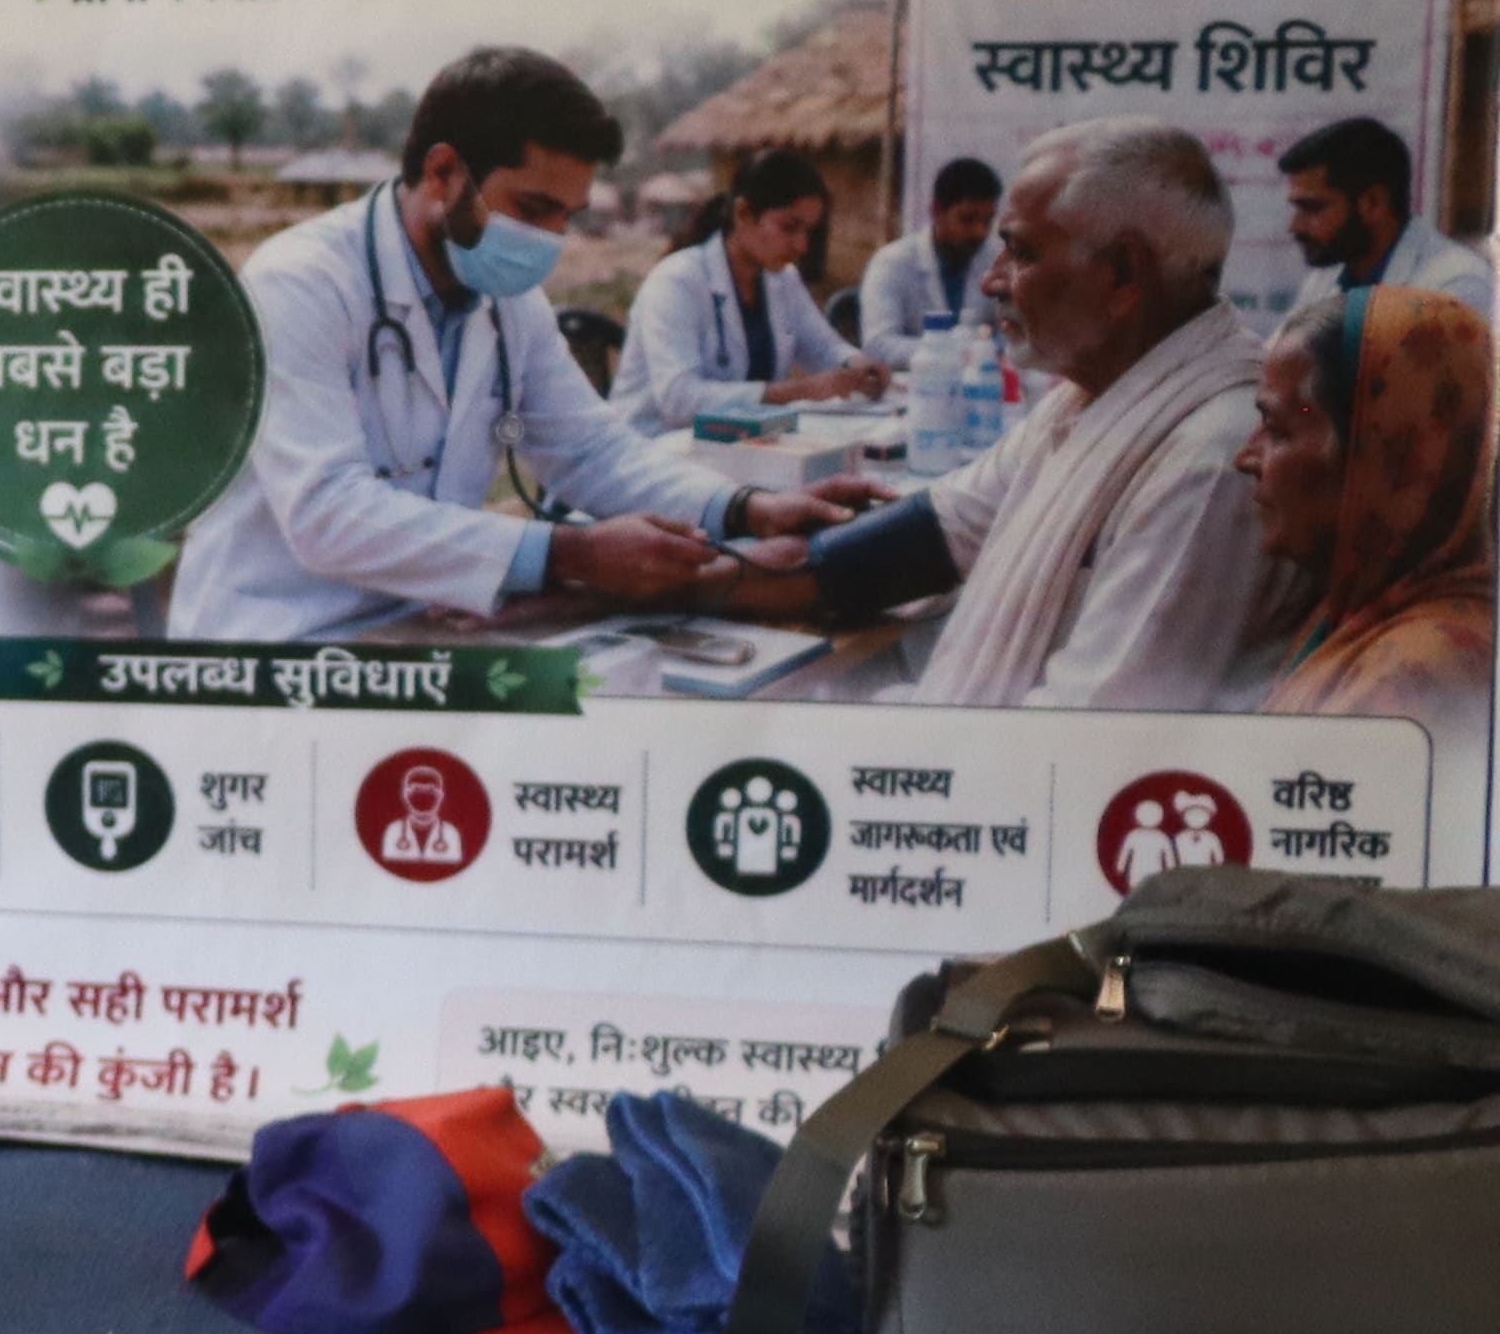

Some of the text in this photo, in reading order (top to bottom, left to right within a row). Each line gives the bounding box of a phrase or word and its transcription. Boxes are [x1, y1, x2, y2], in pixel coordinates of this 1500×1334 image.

[973, 19, 1377, 93] स्वास्थ्य शिविर
[141, 253, 194, 321] ही
[100, 344, 191, 402] बड़ा
[14, 406, 139, 472] धन है
[98, 654, 259, 695] उपलब्ध
[198, 771, 267, 812] शुगर
[513, 779, 621, 815] स्वास्थ्य
[851, 764, 951, 800] स्वास्थ्य
[1272, 770, 1355, 811] वरिष्ठ
[196, 820, 264, 859] जांच
[513, 830, 619, 874] परामर्श
[990, 813, 1028, 856] एवं
[1270, 820, 1392, 859] नागरिक
[848, 869, 965, 908] मार्गदर्शन
[67, 971, 145, 1022] सही
[159, 977, 303, 1031] परामर्श
[26, 1039, 78, 1088] की
[97, 1041, 194, 1101] कुंजी
[209, 1048, 258, 1101] है।
[478, 1023, 575, 1063] आइए,
[741, 1038, 863, 1075] स्वास्थ्य
